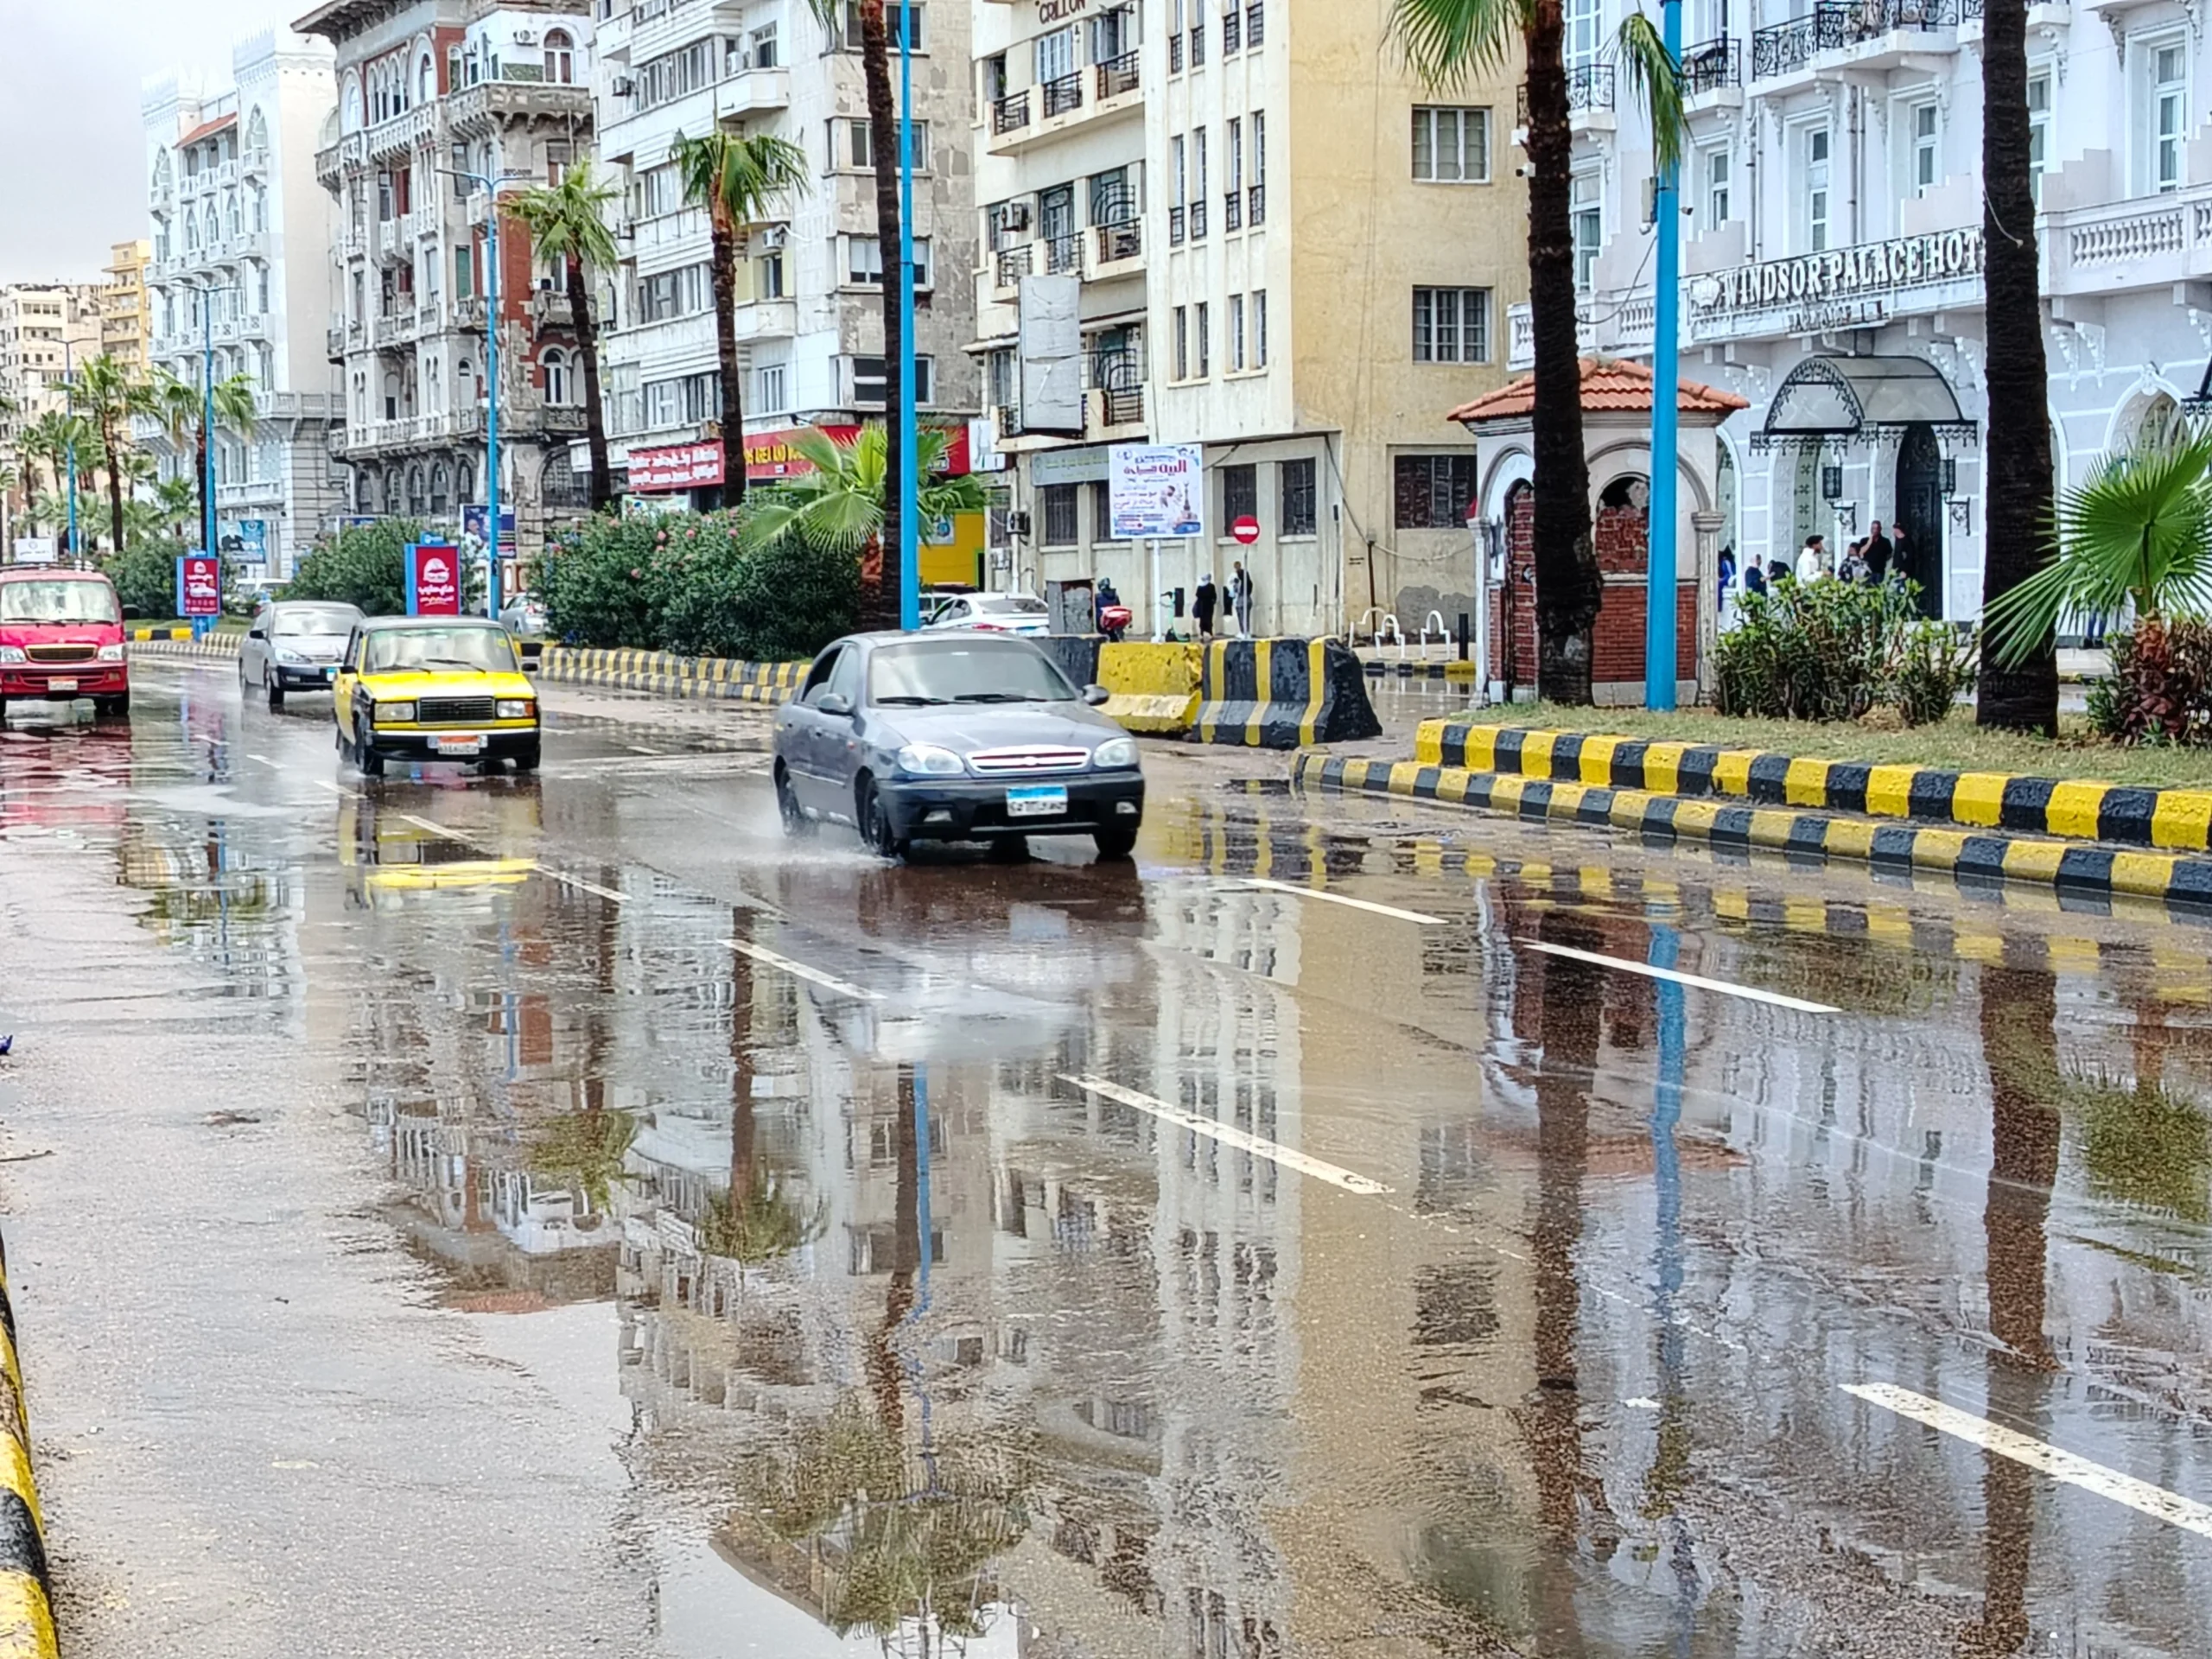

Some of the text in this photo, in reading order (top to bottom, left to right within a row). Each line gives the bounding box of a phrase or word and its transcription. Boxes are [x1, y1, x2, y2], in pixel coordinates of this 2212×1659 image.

[1719, 228, 1985, 307] WINDSOR PALACE HOT
